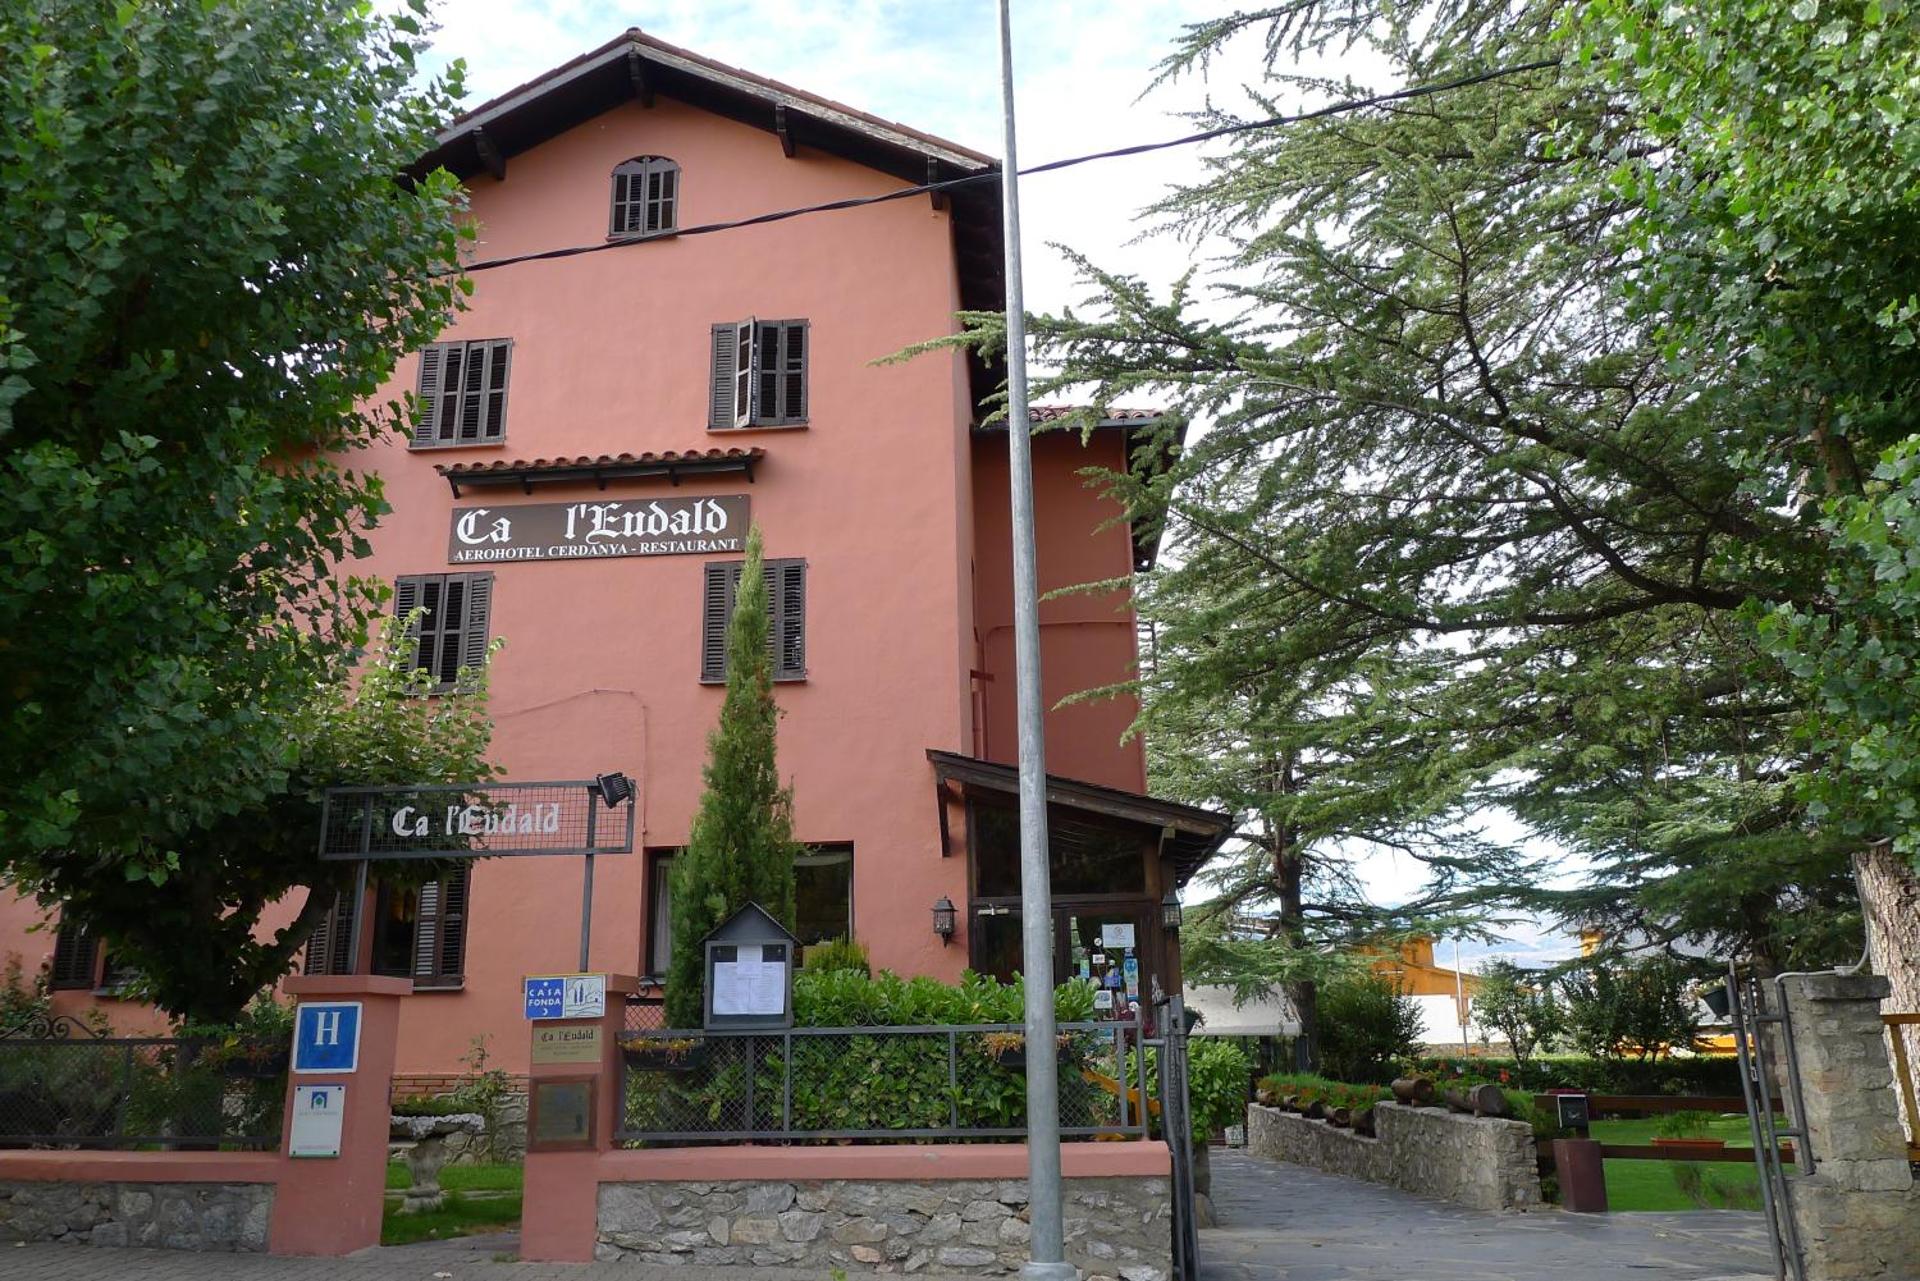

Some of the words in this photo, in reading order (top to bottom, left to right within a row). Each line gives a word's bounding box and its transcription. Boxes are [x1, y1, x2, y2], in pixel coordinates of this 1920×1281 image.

[457, 508, 512, 545] Ca
[454, 546, 545, 561] AEROHOTEL
[548, 543, 628, 557] CERDANYA
[640, 538, 738, 553] RESTAURANT
[392, 805, 429, 837] Ca
[446, 803, 560, 836] l'Eudald
[528, 988, 562, 997] CASA
[528, 998, 562, 1007] FONDA
[313, 1011, 341, 1045] H
[541, 1031, 554, 1042] Ca
